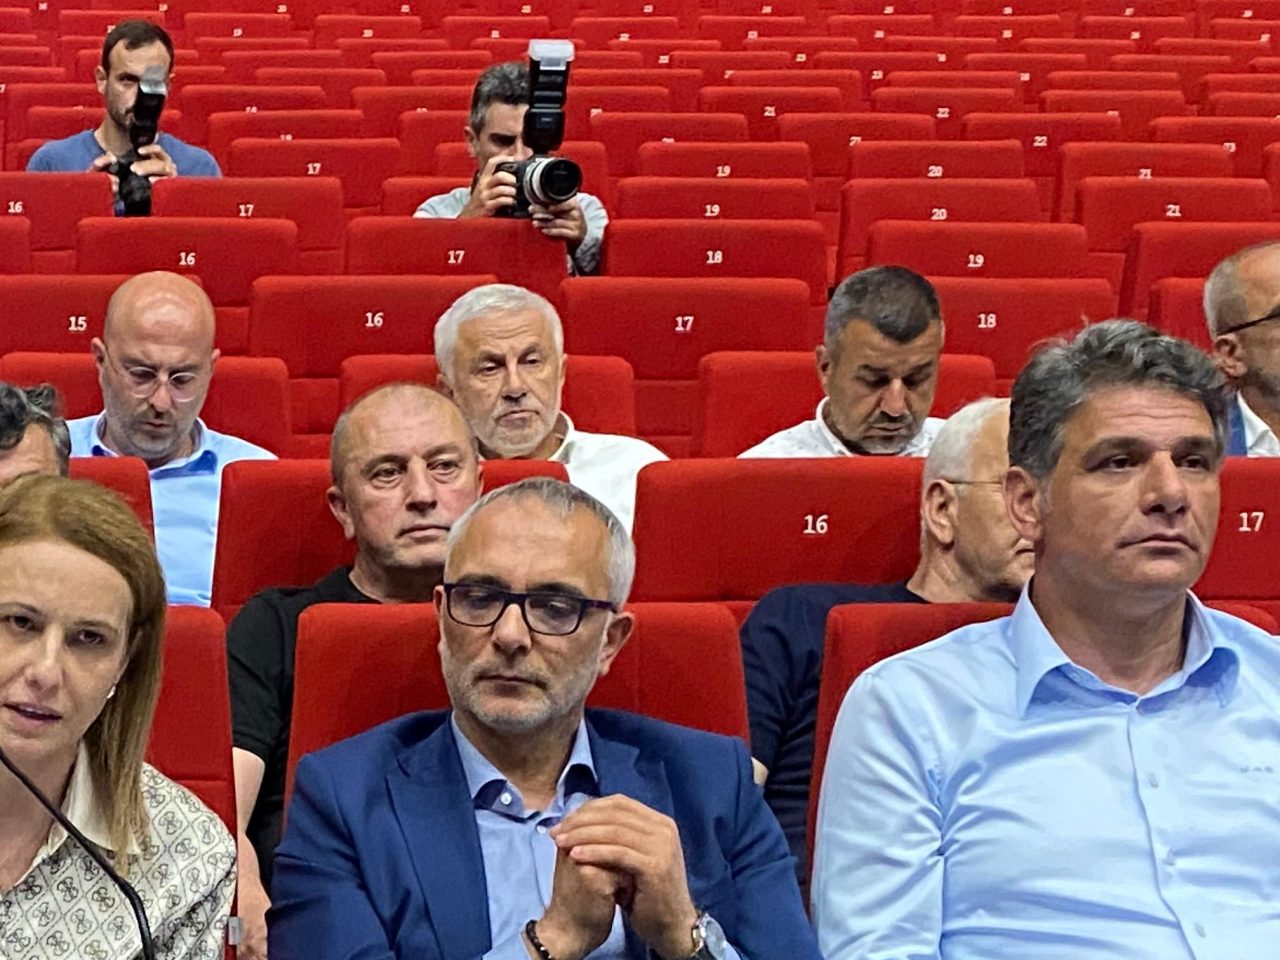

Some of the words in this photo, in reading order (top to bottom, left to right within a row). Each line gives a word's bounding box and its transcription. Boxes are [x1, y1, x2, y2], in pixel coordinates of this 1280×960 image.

[936, 107, 950, 118] 22
[1033, 135, 1048, 147] 22
[307, 162, 322, 175] 17
[716, 165, 731, 178] 19
[927, 165, 944, 177] 20
[1138, 168, 1153, 180] 21
[7, 201, 23, 214] 16
[239, 203, 255, 217] 17
[704, 204, 721, 217] 19
[930, 208, 948, 221] 20
[1165, 204, 1182, 217] 21
[179, 251, 196, 266] 16
[447, 250, 465, 264] 17
[706, 250, 723, 264] 18
[967, 254, 985, 268] 19
[68, 315, 88, 332] 15
[365, 311, 384, 328] 16
[675, 315, 695, 332] 17
[977, 313, 997, 329] 18
[803, 514, 829, 534] 16
[1238, 511, 1265, 532] 17
